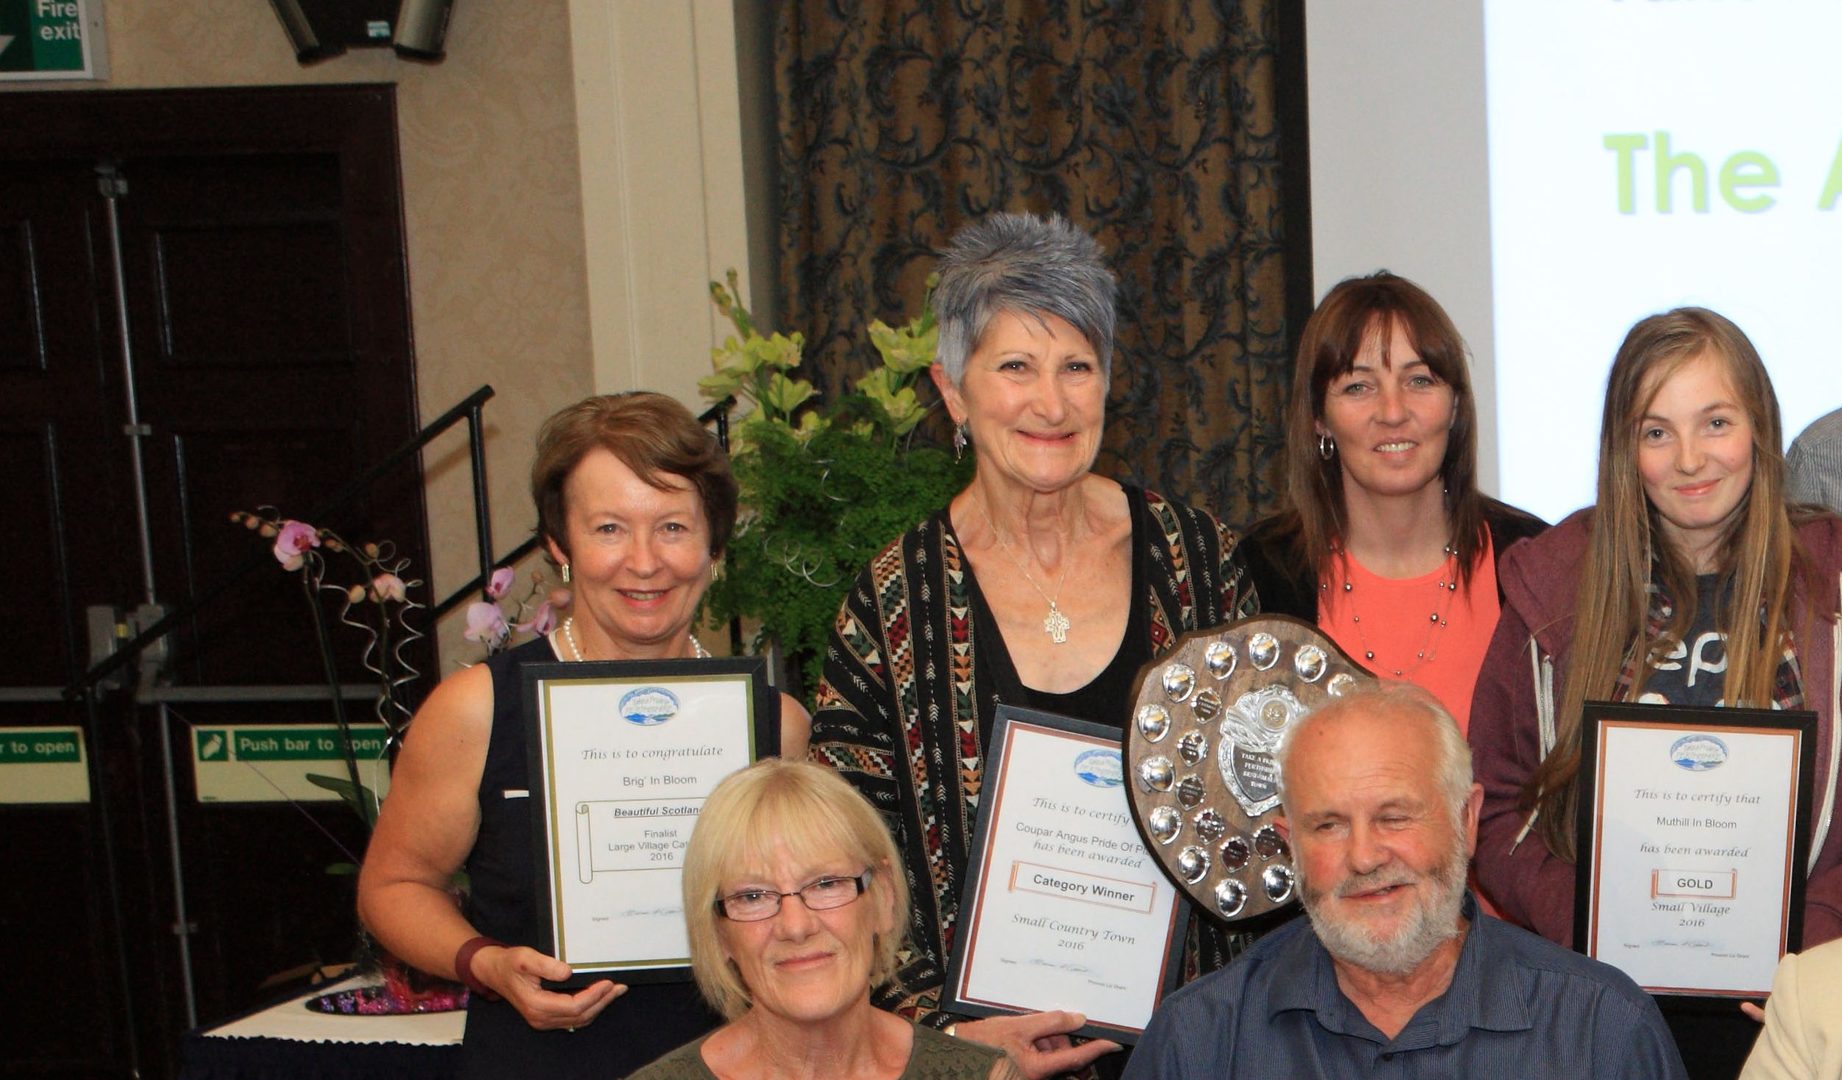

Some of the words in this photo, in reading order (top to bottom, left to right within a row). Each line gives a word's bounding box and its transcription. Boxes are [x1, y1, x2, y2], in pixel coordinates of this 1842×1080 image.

[37, 0, 77, 17] Fire
[41, 21, 81, 40] exit
[1603, 131, 1782, 215] The
[11, 741, 28, 753] to
[35, 741, 75, 756] open
[240, 737, 278, 751] Push
[285, 737, 311, 751] bar
[317, 738, 334, 750] to
[343, 738, 381, 753] pen
[582, 748, 608, 760] This
[612, 749, 621, 759] is
[626, 748, 638, 759] to
[642, 745, 723, 761] congratulate
[650, 776, 660, 785] In
[663, 775, 697, 786] Bloom
[1634, 788, 1658, 800] This
[1663, 791, 1672, 800] is
[1676, 790, 1687, 801] to
[1691, 790, 1732, 805] certify
[1736, 793, 1761, 805] that
[614, 807, 659, 817] Beautiful
[1033, 796, 1057, 811] This
[1061, 803, 1071, 813] is
[1074, 804, 1087, 817] to
[1089, 809, 1131, 827] certify
[1656, 816, 1690, 827] Muthill
[1693, 818, 1702, 827] In
[1705, 819, 1737, 829] Bloom
[644, 829, 677, 839] Finalist
[1016, 822, 1054, 839] Coupar
[1056, 830, 1089, 846] Angus
[1091, 836, 1118, 850] Pride
[1121, 841, 1135, 853] Of
[608, 842, 635, 853] Large
[637, 840, 670, 851] Village
[1033, 839, 1056, 853] has
[1058, 843, 1085, 859] been
[1088, 850, 1144, 869] awarded
[1640, 843, 1660, 855] has
[1664, 844, 1691, 856] been
[1694, 847, 1750, 858] awarded
[650, 852, 674, 861] 2016
[1033, 873, 1089, 895] Category
[1092, 884, 1135, 903] Winner
[1677, 878, 1713, 890] GOLD
[1651, 901, 1685, 913] Small
[1689, 902, 1731, 917] Village
[1012, 913, 1047, 929] Small
[1049, 919, 1099, 940] Country
[1103, 930, 1135, 945] Town
[1679, 918, 1705, 927] 2016
[1058, 938, 1085, 951] 2016
